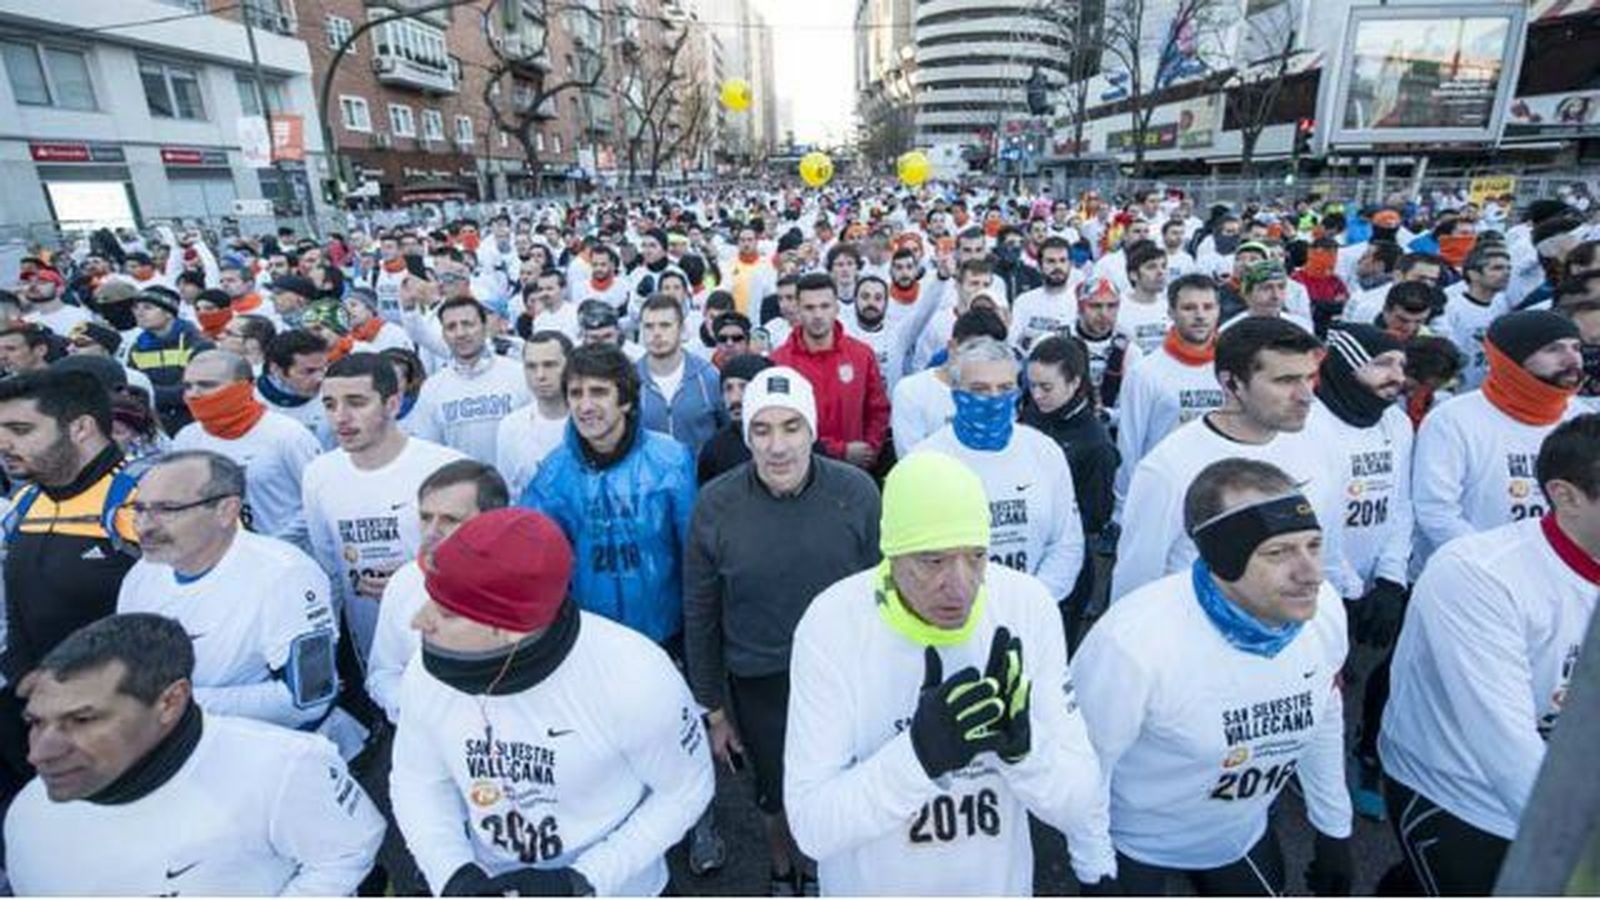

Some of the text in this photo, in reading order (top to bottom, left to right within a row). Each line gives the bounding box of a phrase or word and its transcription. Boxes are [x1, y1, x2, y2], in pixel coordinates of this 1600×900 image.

[1346, 496, 1389, 527] 2016
[1222, 691, 1312, 726] SAN SILVESTRE
[1224, 709, 1314, 746] VALLECANA
[910, 789, 1000, 843] 2016
[481, 811, 563, 863] 2016
